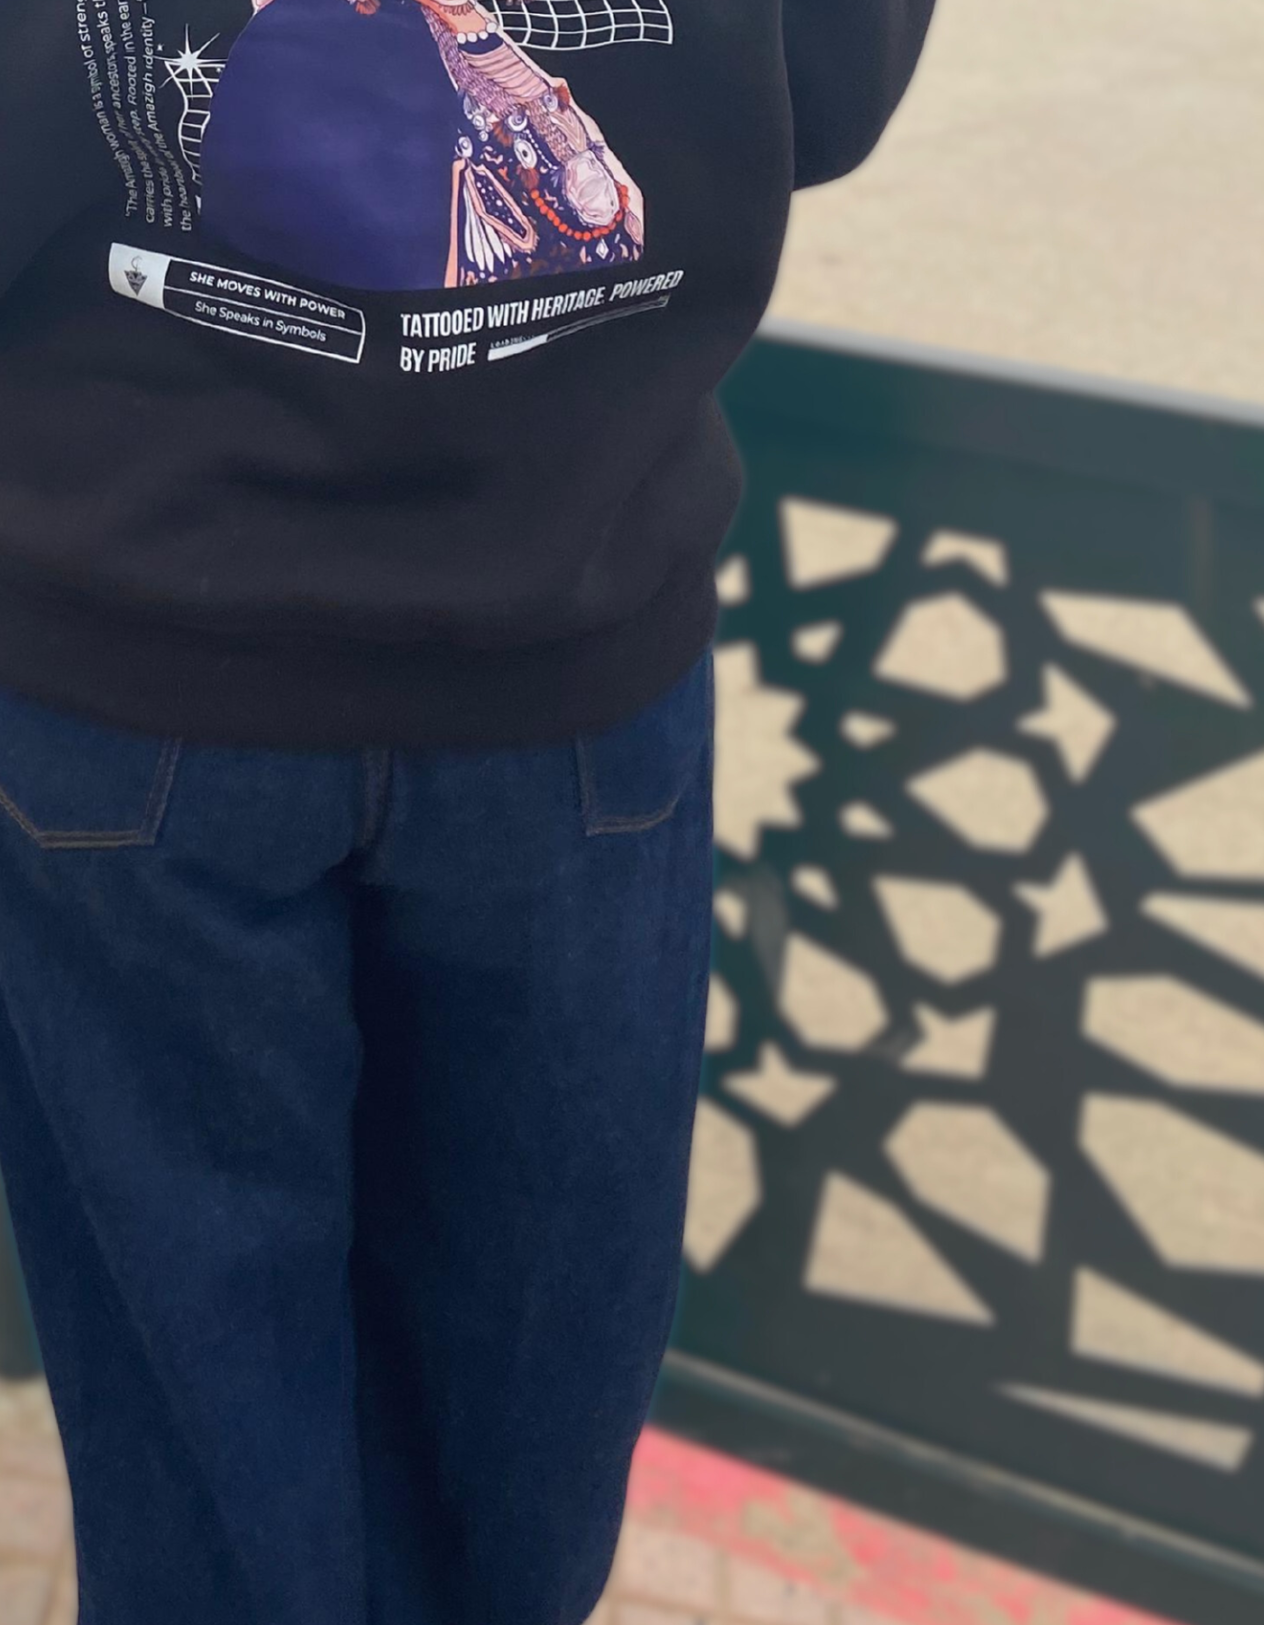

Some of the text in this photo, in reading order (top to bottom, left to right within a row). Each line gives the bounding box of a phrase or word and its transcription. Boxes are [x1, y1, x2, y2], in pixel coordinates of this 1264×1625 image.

[96, 11, 116, 53] speaks
[120, 21, 133, 41] the
[124, 41, 135, 53] in
[84, 59, 102, 93] symbol
[124, 56, 136, 105] Rooted
[92, 101, 104, 111] is
[142, 73, 160, 132] Amazigh
[96, 111, 119, 150] woman
[153, 133, 167, 149] the
[141, 161, 153, 178] the
[143, 179, 154, 223] carries
[160, 199, 172, 227] with
[180, 209, 192, 231] the
[189, 271, 346, 320] SHE MOVES WITH POWER
[400, 306, 484, 338] TATTOOED
[486, 299, 530, 329] WITH
[609, 269, 685, 303] POWERED
[195, 301, 327, 343] She Speaks in Symbols
[399, 342, 477, 373] BY PRIDE
